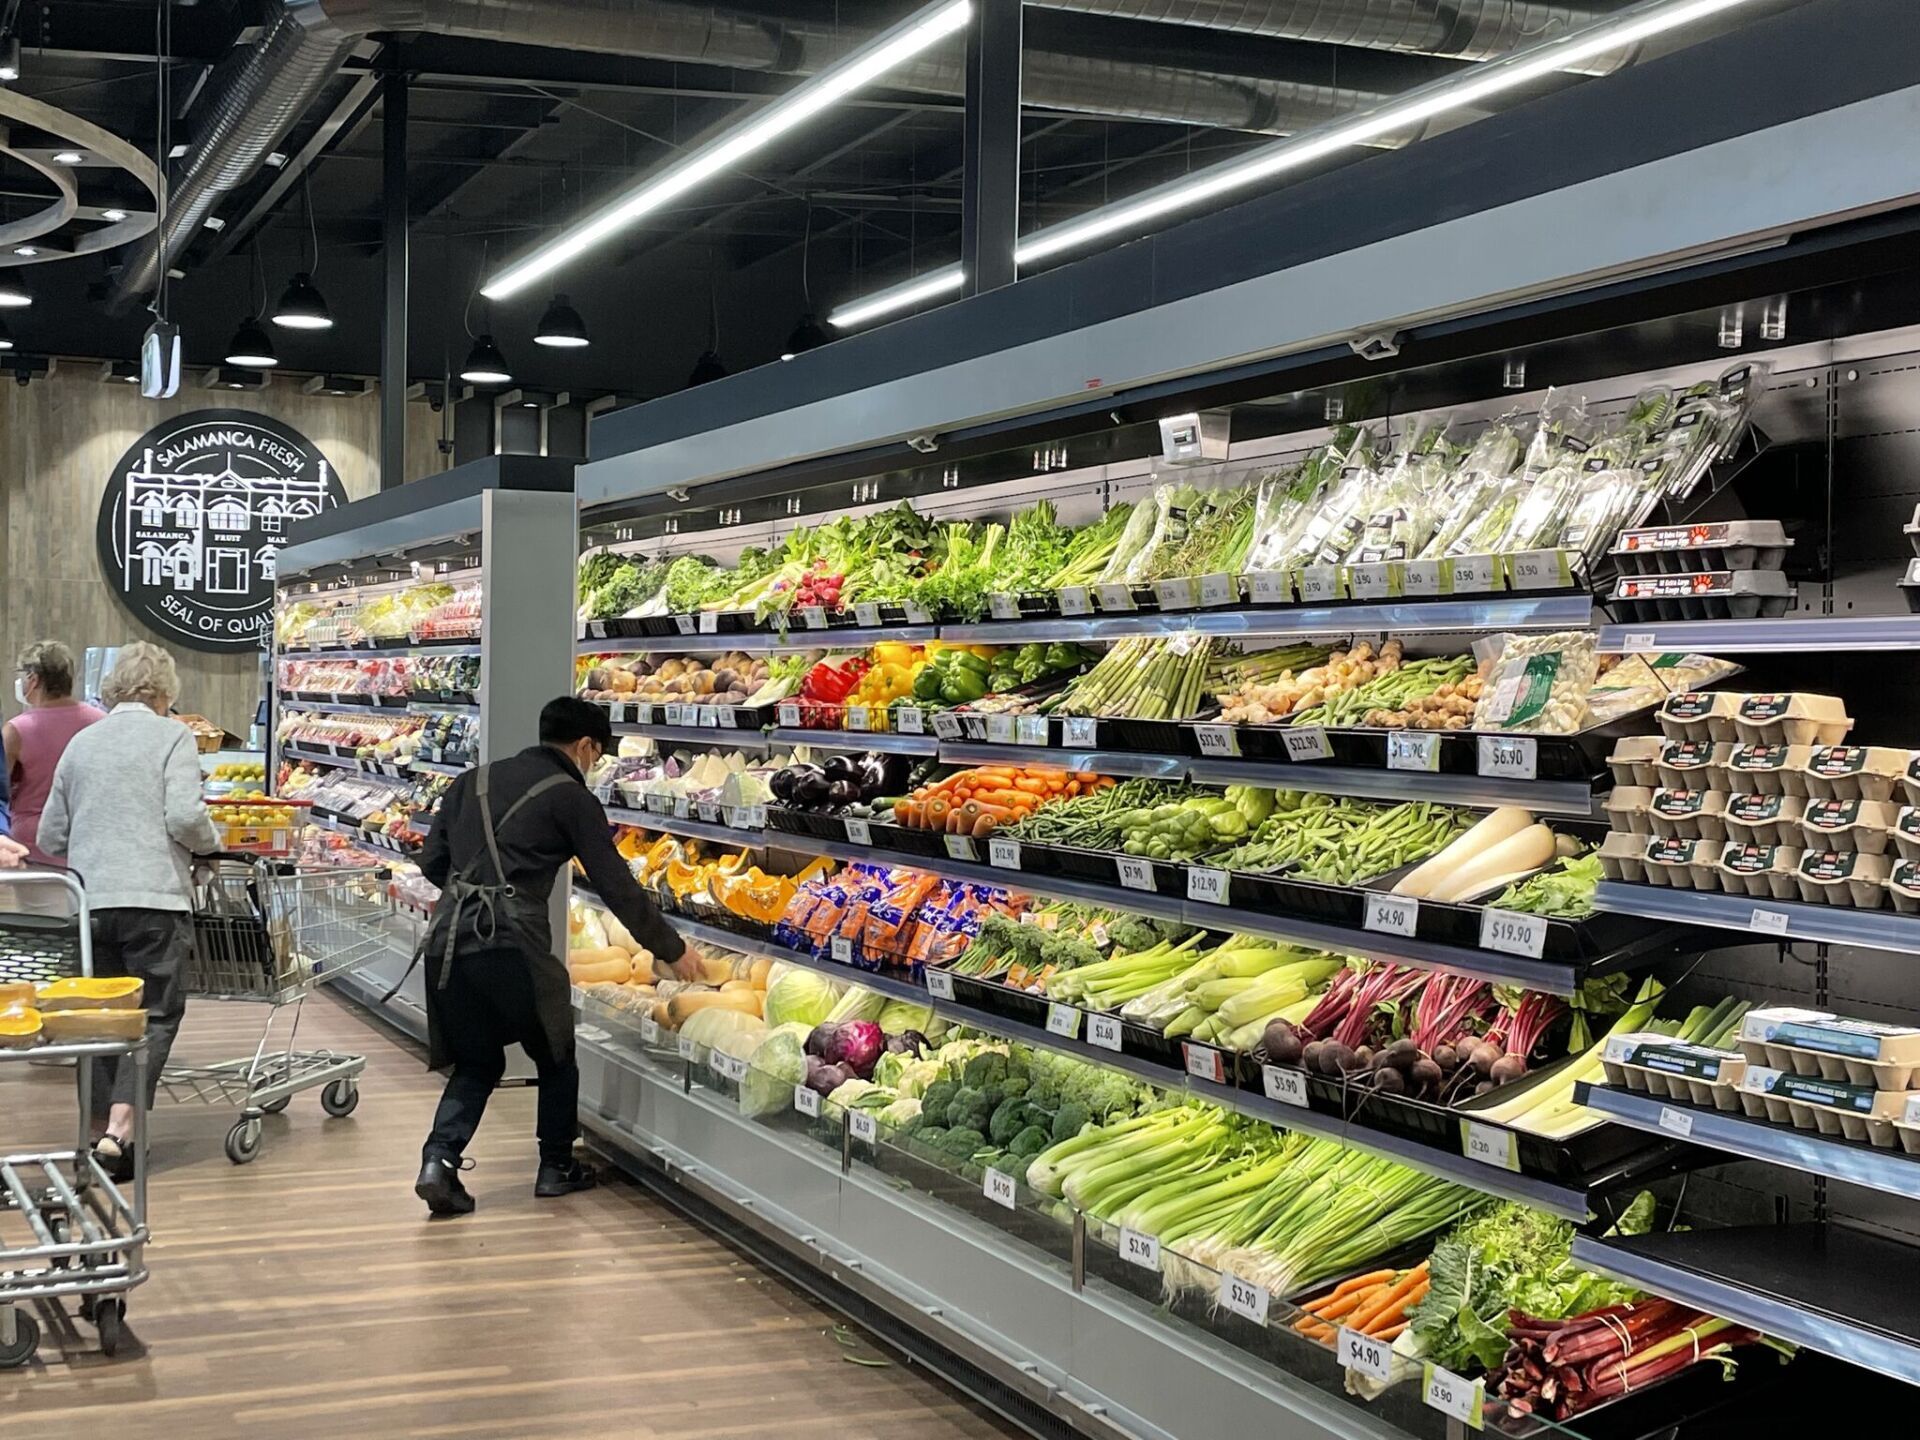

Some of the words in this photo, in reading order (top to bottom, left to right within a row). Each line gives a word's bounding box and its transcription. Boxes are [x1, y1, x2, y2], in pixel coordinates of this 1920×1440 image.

[157, 431, 255, 467] SALAMANCA
[258, 438, 305, 473] FRESH
[136, 531, 190, 540] SALAMANCA
[214, 534, 242, 542] FRUIT
[267, 536, 289, 544] MAR
[160, 594, 193, 625] SEAL
[199, 616, 223, 632] OF
[227, 608, 274, 633] QUALI
[1200, 734, 1226, 748] $32.90
[1289, 736, 1318, 752] $22.90
[1392, 742, 1423, 759] $1.90
[1493, 747, 1523, 767] $6.90
[1123, 865, 1143, 880] $7.90
[1191, 876, 1218, 892] $12.90
[1376, 907, 1404, 927] $4.90
[1492, 922, 1532, 944] $19.90
[1129, 1237, 1151, 1258] $2.90
[1231, 1283, 1256, 1310] $2.90
[1351, 1341, 1380, 1367] $4.90
